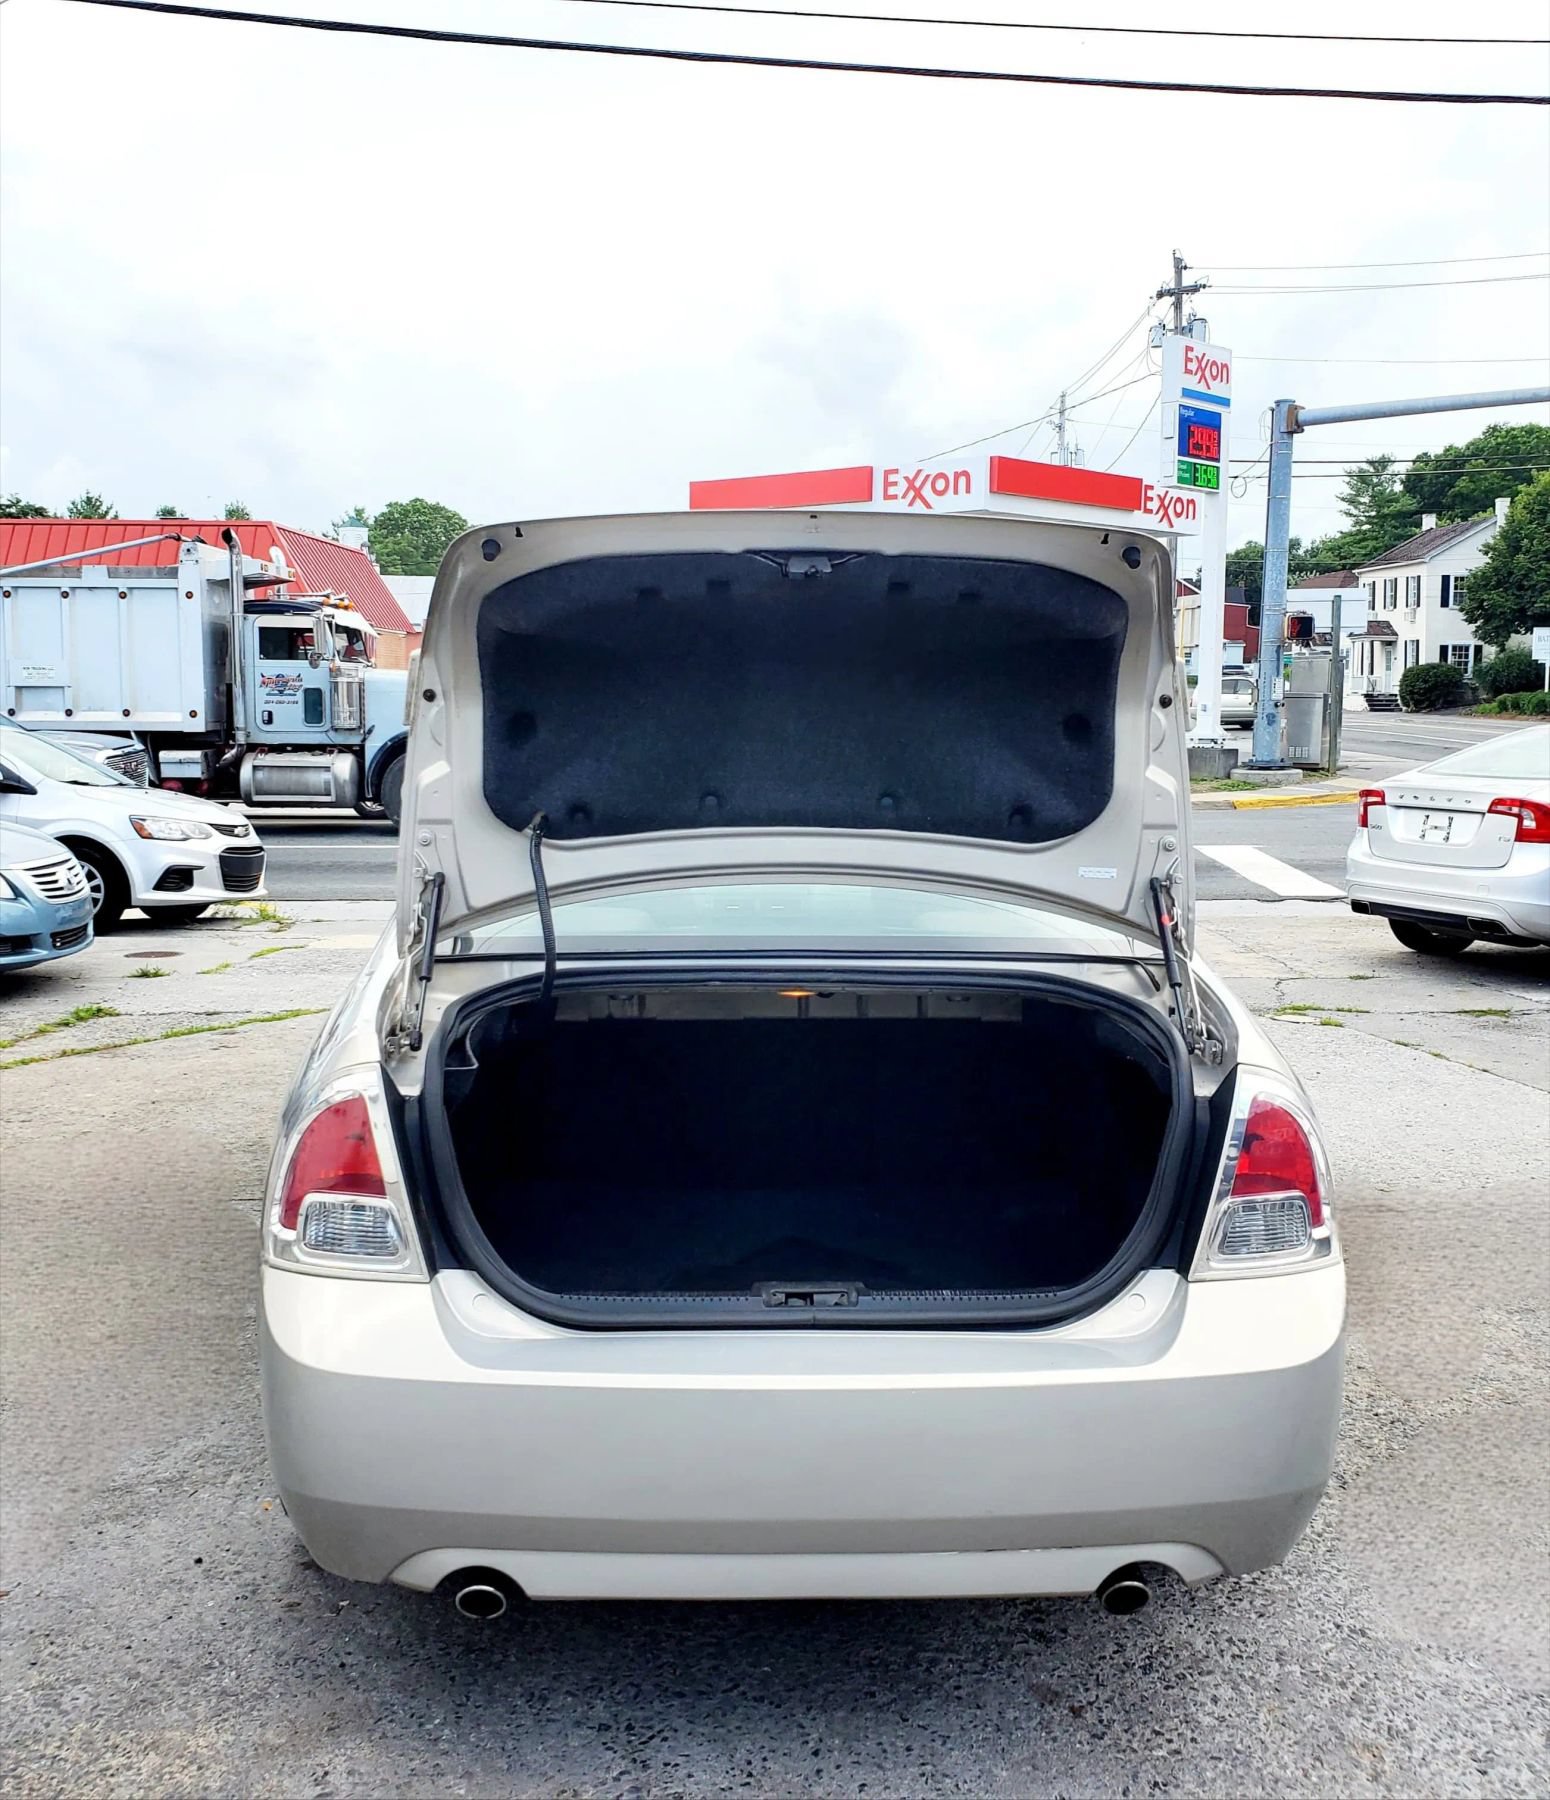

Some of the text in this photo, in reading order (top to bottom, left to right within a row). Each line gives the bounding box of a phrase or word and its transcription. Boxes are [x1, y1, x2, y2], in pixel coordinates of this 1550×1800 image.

[1184, 345, 1230, 390] Exxon
[882, 467, 972, 509] Exxon
[1143, 485, 1197, 528] Exxon
